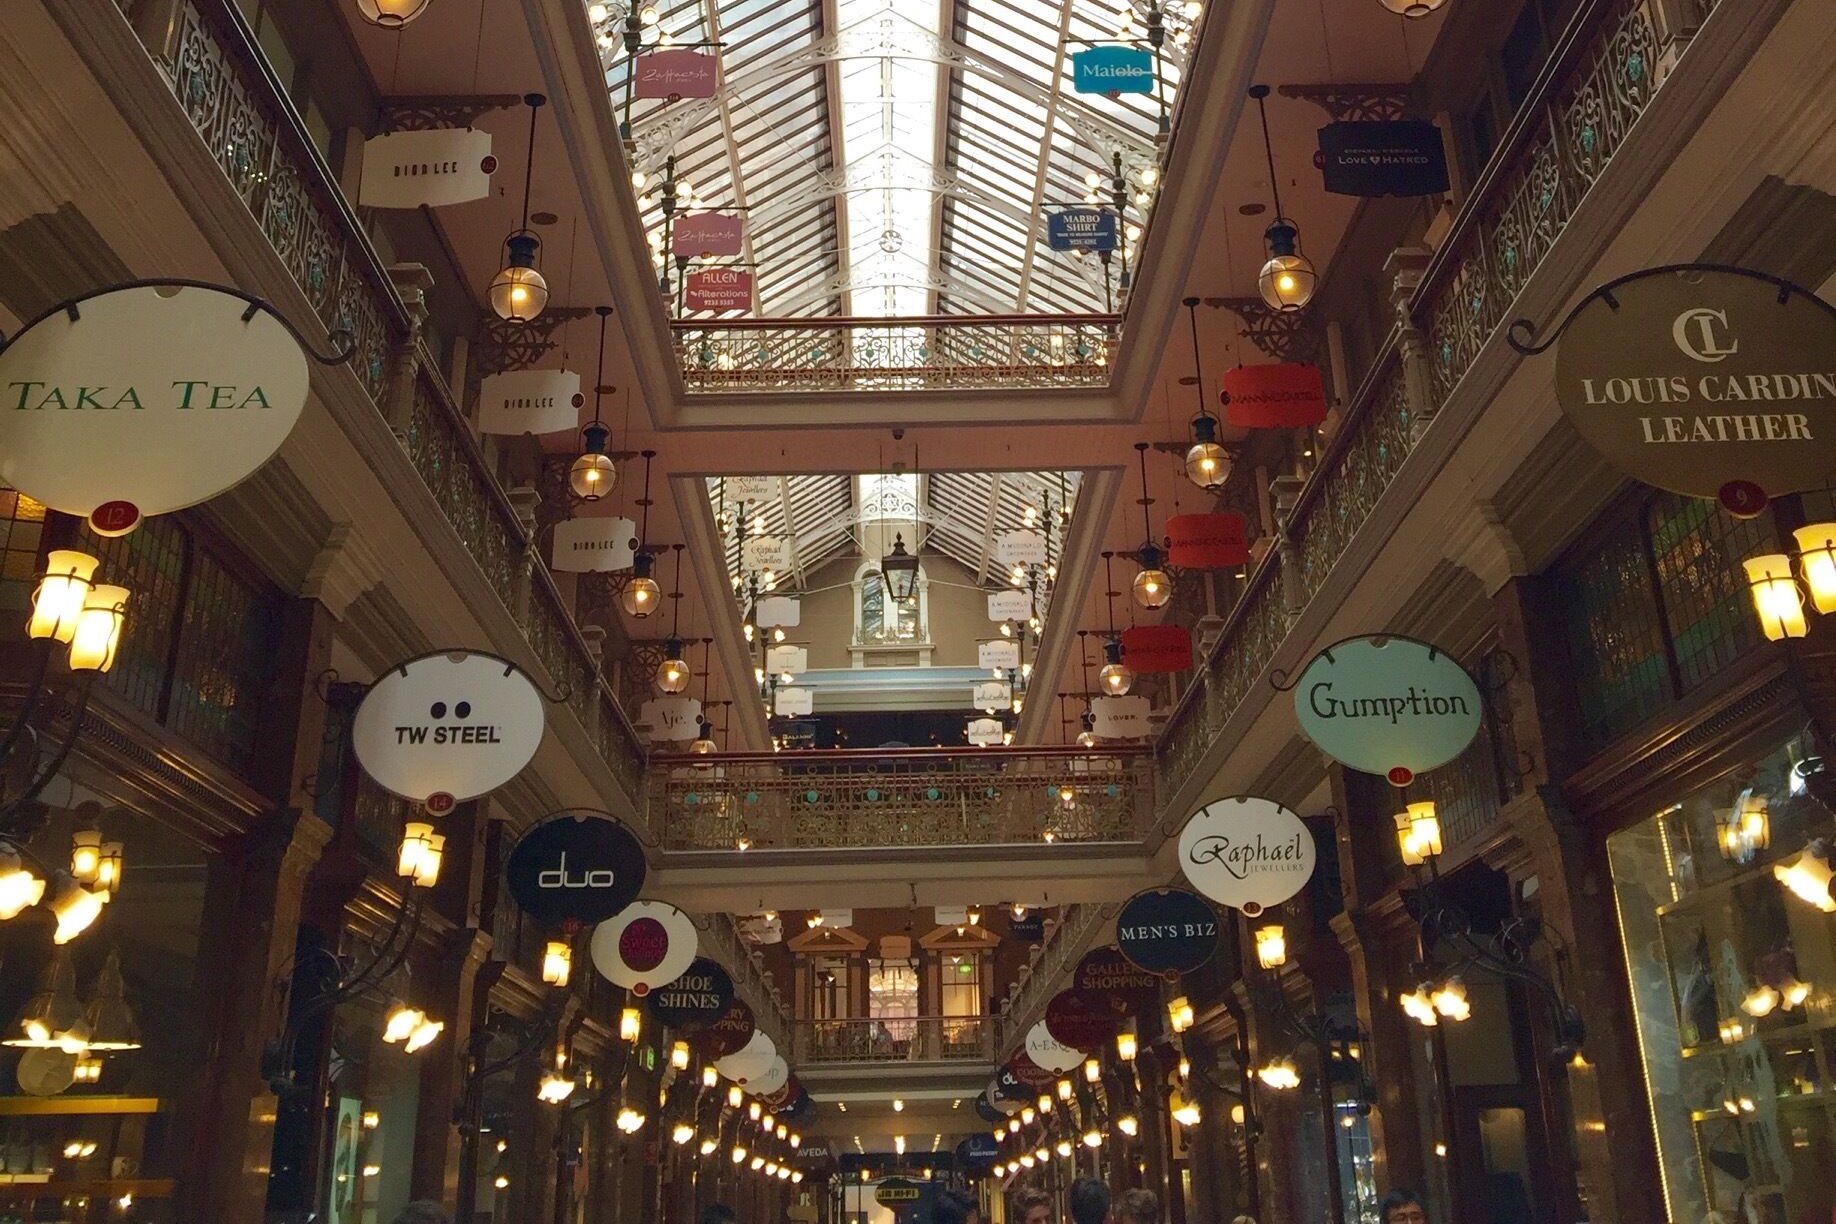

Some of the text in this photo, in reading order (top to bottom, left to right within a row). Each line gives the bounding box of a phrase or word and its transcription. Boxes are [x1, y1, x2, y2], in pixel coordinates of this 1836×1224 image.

[1083, 63, 1144, 78] Maiolo
[1338, 156, 1429, 164] LOVE HATRED
[434, 161, 458, 175] LEE
[1063, 214, 1100, 223] MARBO
[1066, 223, 1098, 232] SHIRT
[702, 272, 738, 284] ALLEN
[698, 289, 748, 298] Alterations
[8, 380, 272, 410] TAKA TEA
[1581, 376, 1691, 405] LOUIS
[535, 397, 554, 408] LEE
[1640, 413, 1814, 444] LEATHER
[1736, 488, 1748, 505] 9
[106, 506, 126, 525] 12
[598, 540, 614, 550] LEE
[1310, 682, 1470, 724] Gumption
[395, 725, 501, 745] TW STEEL
[538, 850, 615, 889] duo
[1250, 863, 1305, 873] JEWELLERS
[1121, 923, 1216, 941] MEN'S BIZ
[668, 975, 713, 991] SHOE
[1082, 976, 1154, 990] SHOPPING
[658, 993, 720, 1009] SHINES
[797, 1147, 829, 1157] AVEDA
